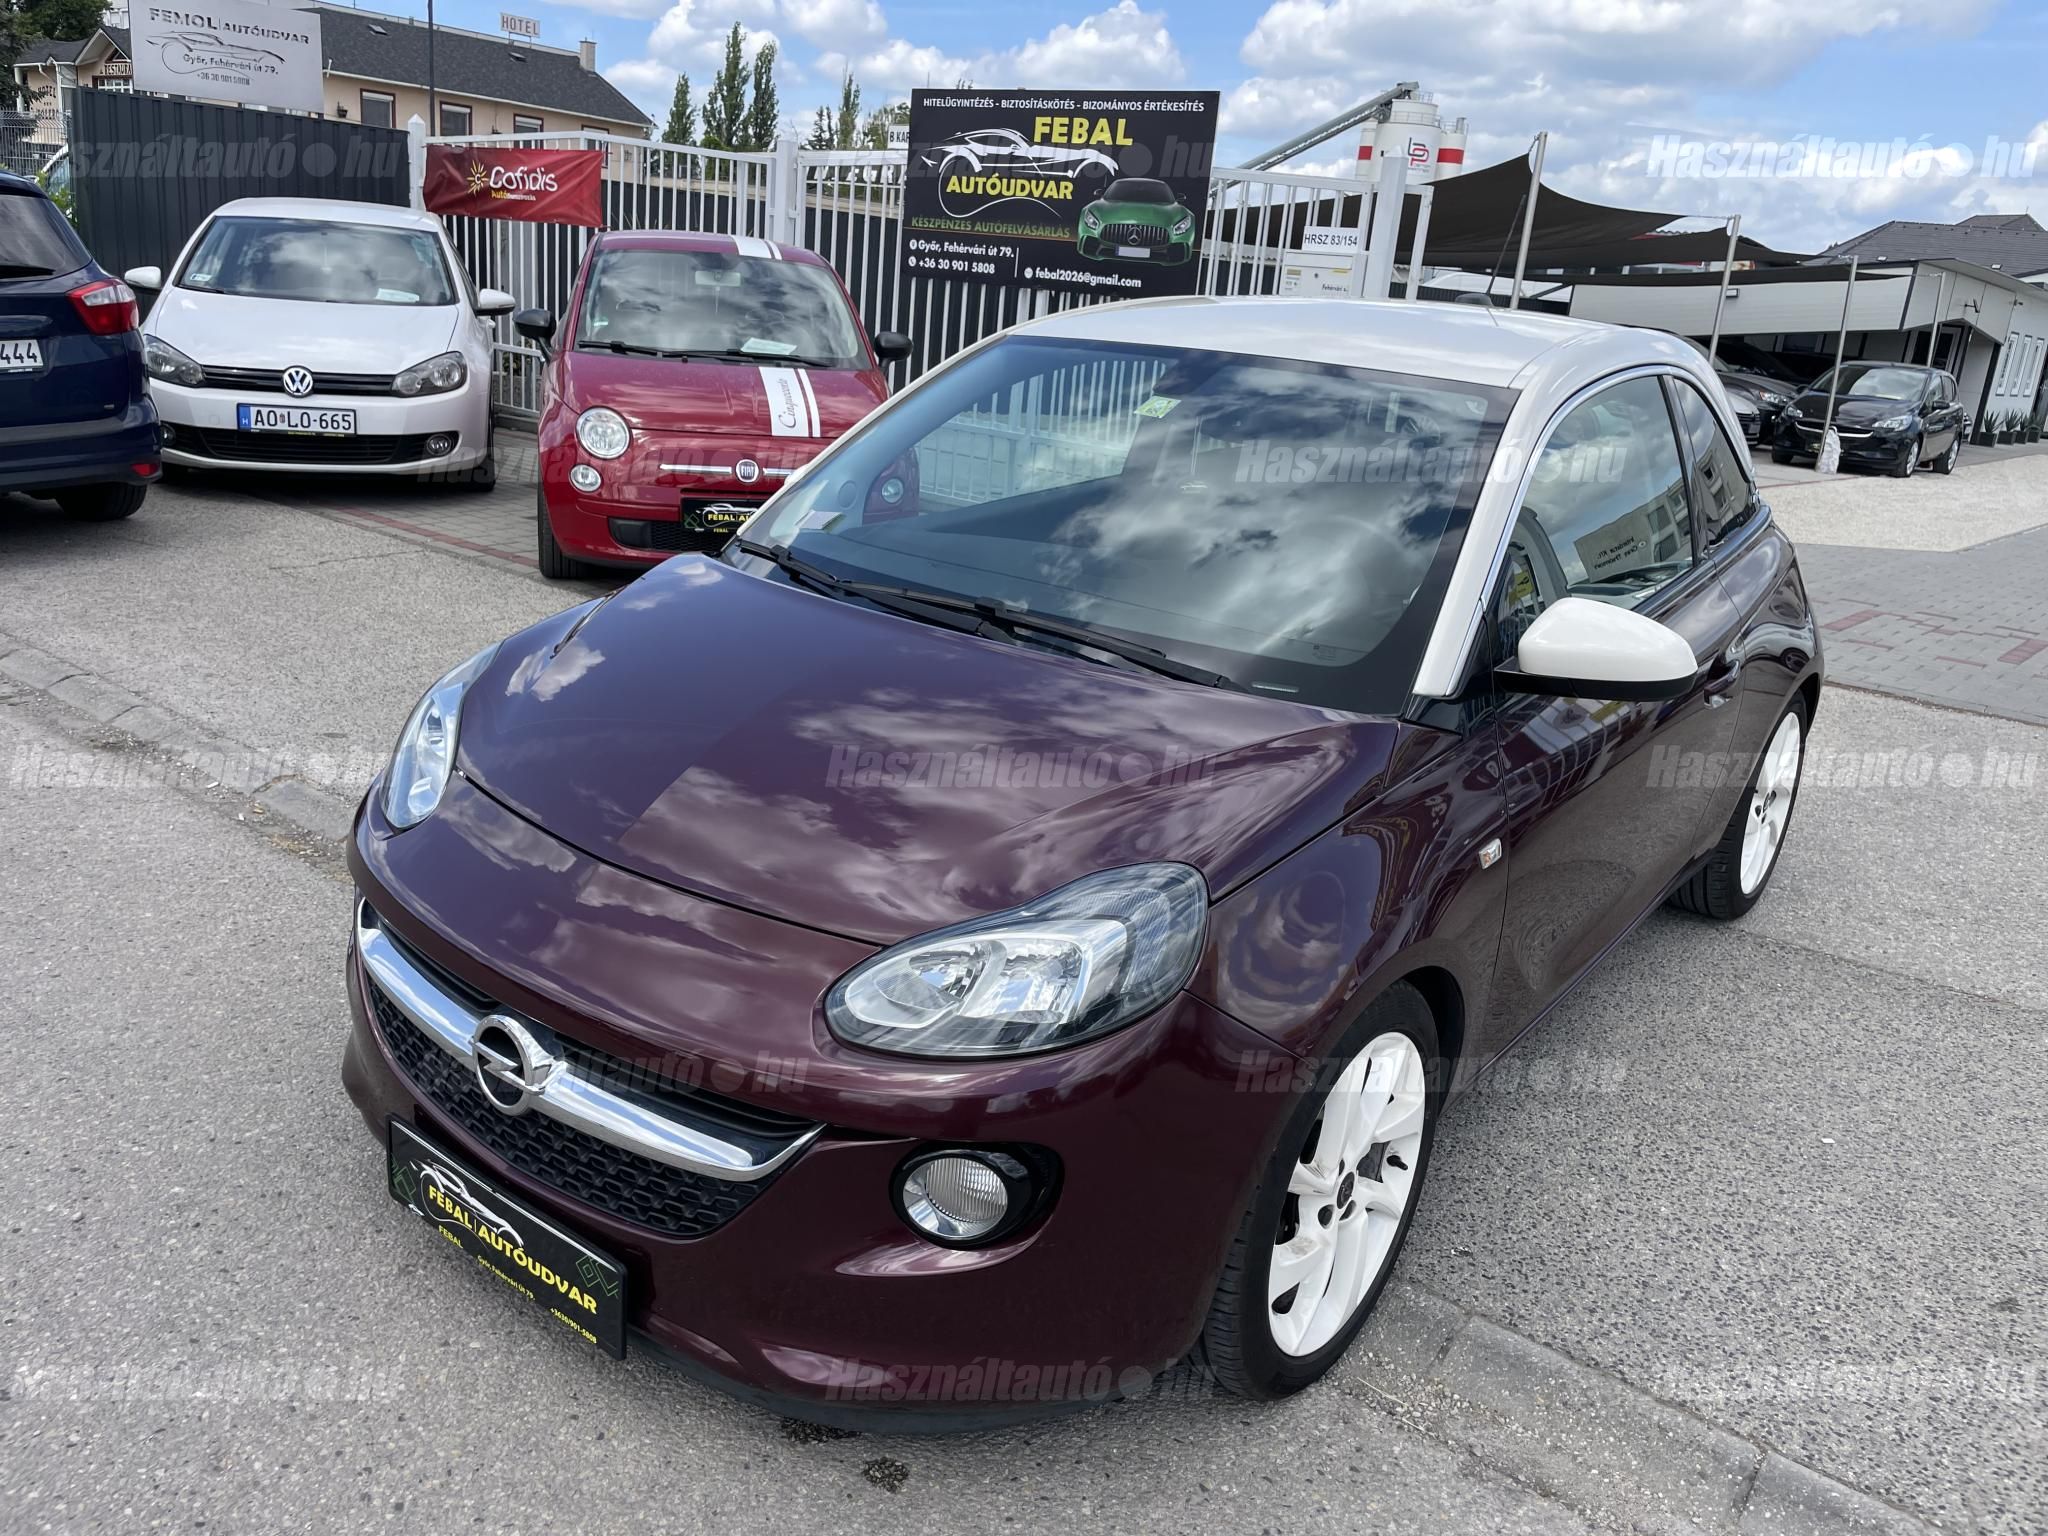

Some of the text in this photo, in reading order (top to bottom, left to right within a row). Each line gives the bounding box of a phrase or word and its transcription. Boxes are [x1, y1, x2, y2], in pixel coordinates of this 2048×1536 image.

[220, 21, 310, 44] AUTÓUDVAR
[502, 15, 539, 36] HOTEL
[923, 97, 1205, 113] HITELÜGYINTÉZÉS BIZTOSÍTÁSKÖTÉS BIZOMÁNYOS ÉRTÉKESÍTÉS
[1033, 116, 1134, 146] FEBAL
[489, 166, 559, 192] Cofidis
[945, 173, 1074, 200] AUTÓUDVAR
[911, 216, 1071, 240] KÉSZPÉNZES AUTÓFELVÁSÁRLÁS
[918, 240, 1014, 259] Győr, Fehérvári út 79.
[1304, 234, 1358, 247] HRSZ 83/154
[918, 258, 996, 275] +36 30 901 5808
[1035, 267, 1142, 289] febal2026@gmail.com
[740, 466, 756, 477] FIAT
[707, 513, 736, 522] FEBAL
[438, 1224, 464, 1249] FEBAL
[428, 1184, 598, 1315] FEBAL AUTÓUDVAR
